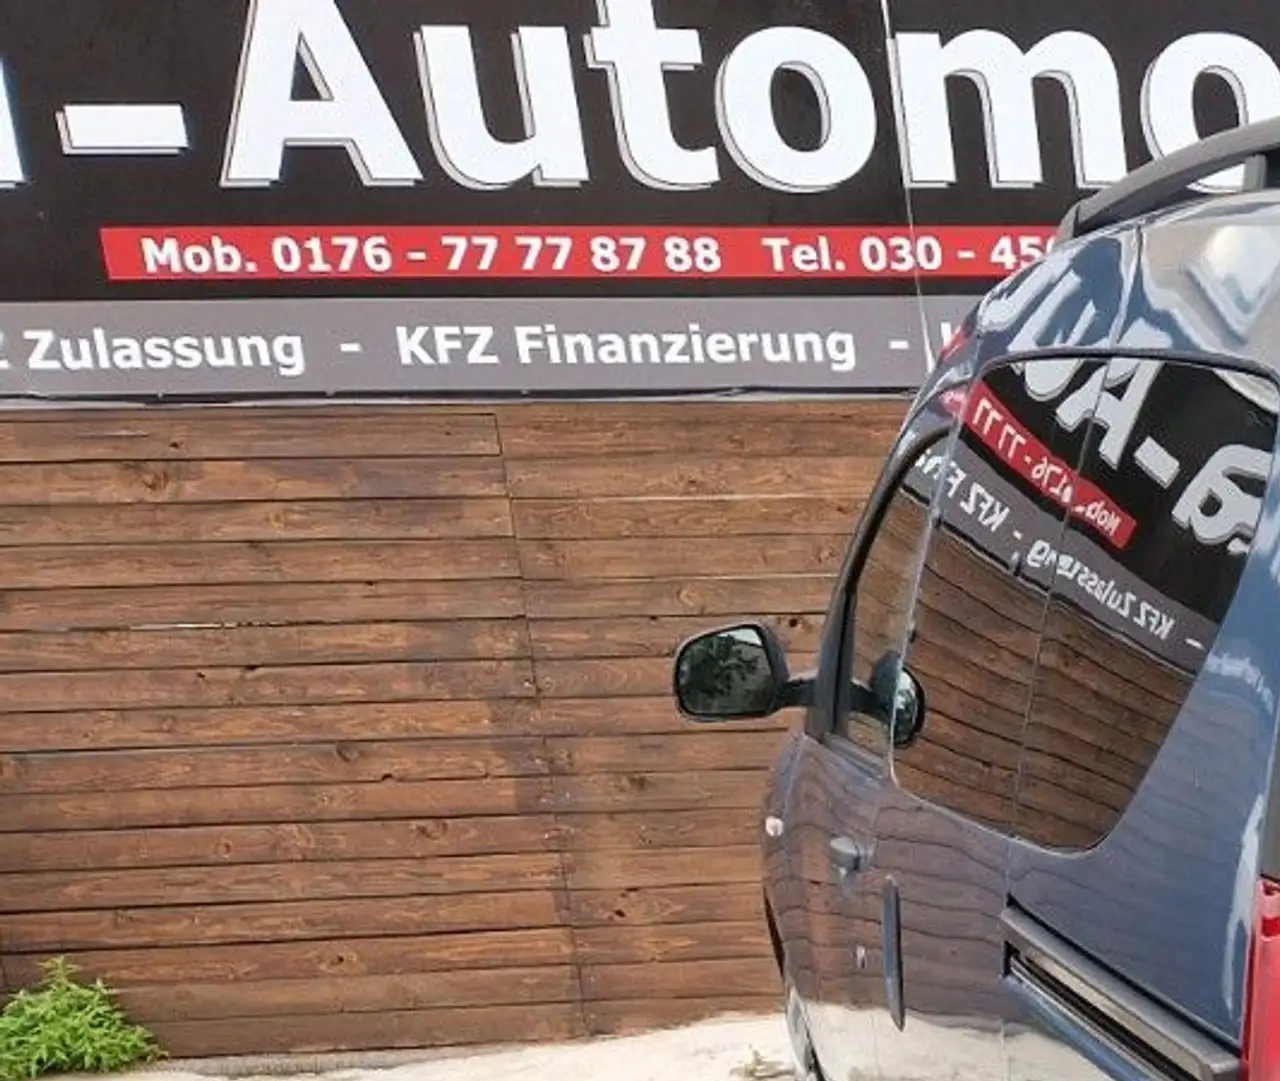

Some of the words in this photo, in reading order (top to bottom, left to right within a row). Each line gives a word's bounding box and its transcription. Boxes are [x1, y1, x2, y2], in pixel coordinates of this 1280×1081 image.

[140, 237, 257, 273] Mob.
[272, 237, 393, 273] 0176
[441, 236, 499, 271] 77
[515, 236, 573, 271] 77
[590, 236, 647, 272] 87
[663, 236, 722, 272] 88
[762, 235, 846, 273] Tel.
[860, 235, 942, 271] 030
[990, 235, 1055, 270] 45
[22, 327, 305, 375] Zulassung
[395, 325, 499, 365] KFZ
[514, 323, 856, 372] Finanzierung
